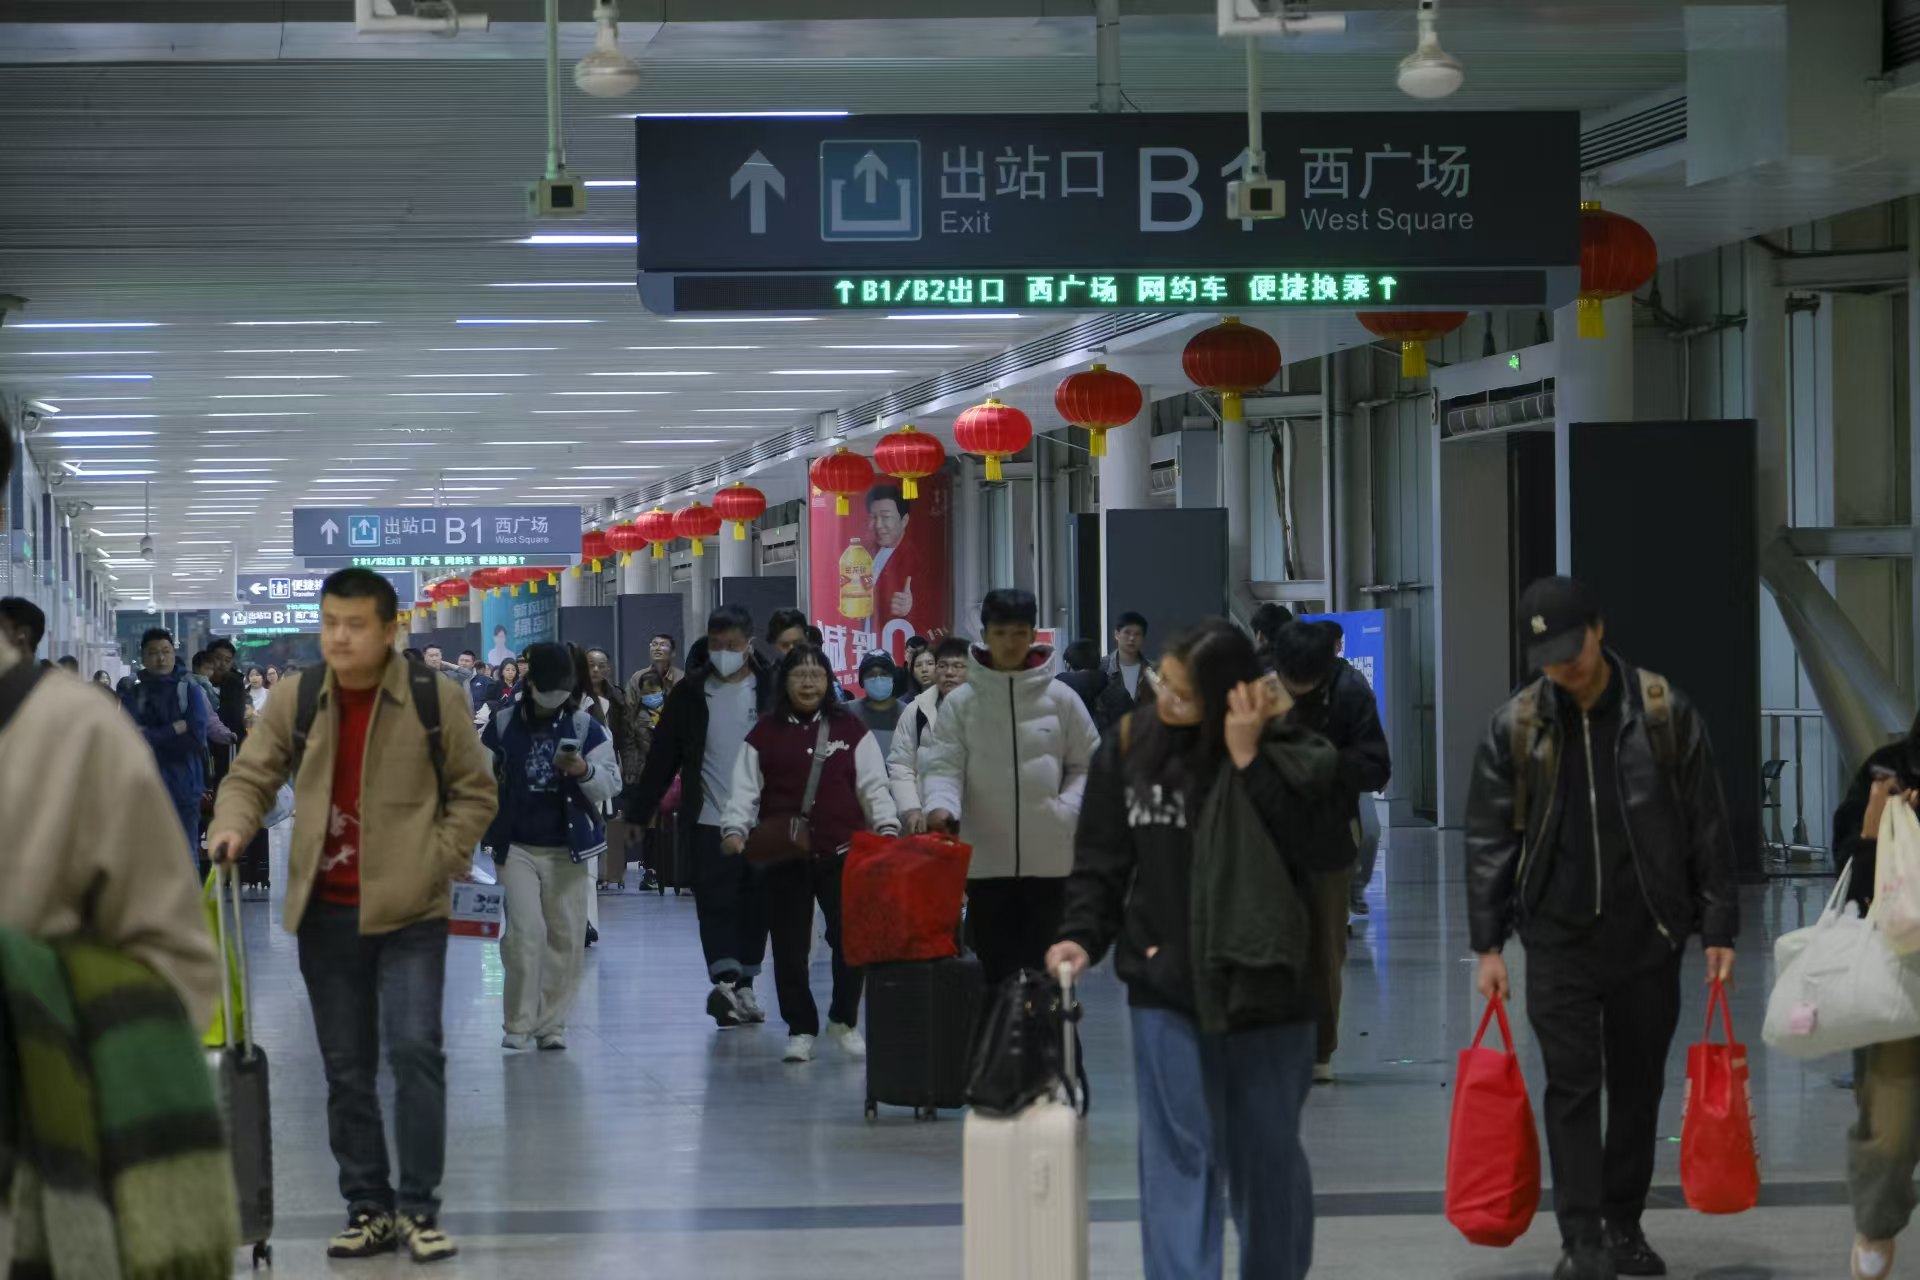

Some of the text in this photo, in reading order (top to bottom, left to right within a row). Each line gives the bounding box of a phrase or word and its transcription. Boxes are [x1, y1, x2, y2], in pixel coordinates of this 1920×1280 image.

[940, 145, 1105, 201] 出站口
[1300, 144, 1471, 199] 西广场
[940, 210, 991, 234] Exit
[1300, 207, 1474, 235] West Square
[862, 273, 1370, 304] B1/B2出口 西广场 网约车 便捷换乘
[384, 518, 437, 535] 出站口
[445, 517, 482, 545] B1
[495, 516, 549, 534] 西广场
[385, 536, 401, 545] Exit
[495, 535, 550, 546] West Square
[273, 611, 291, 624] B1
